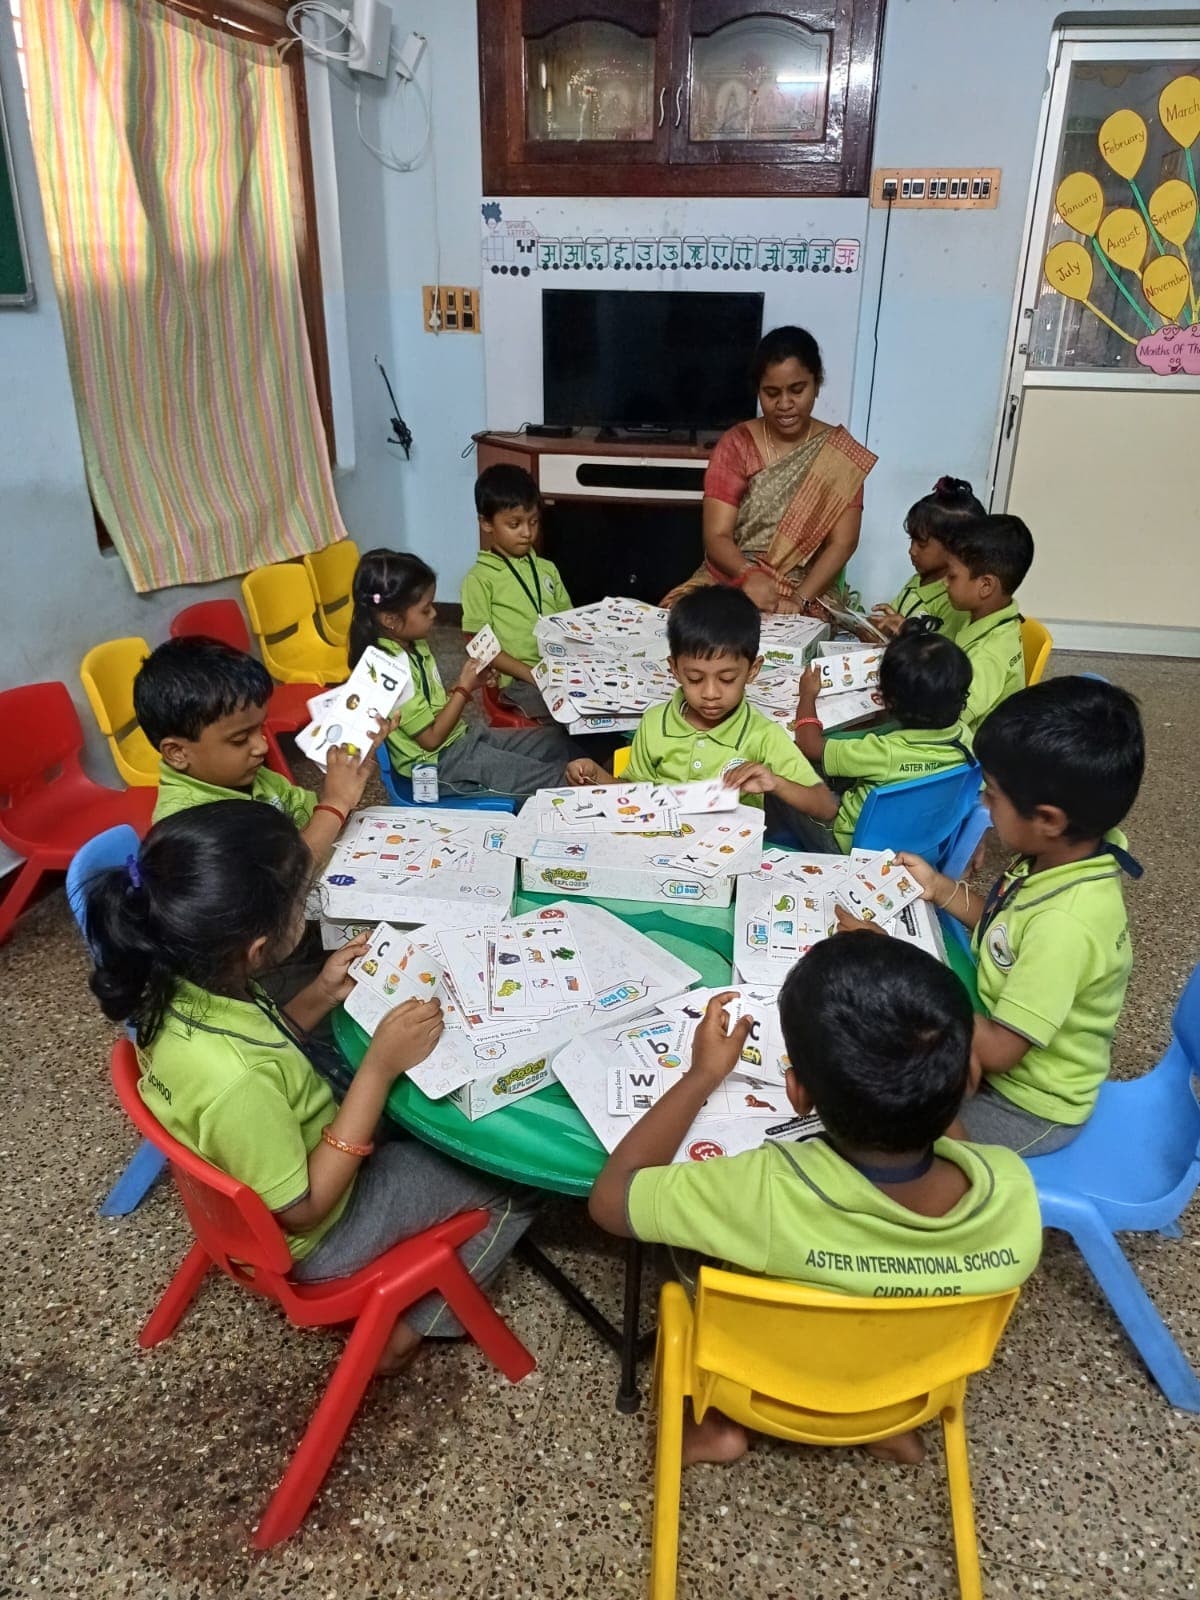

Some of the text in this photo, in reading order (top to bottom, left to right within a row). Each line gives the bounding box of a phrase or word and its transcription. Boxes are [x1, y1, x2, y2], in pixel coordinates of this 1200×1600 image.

[1166, 97, 1200, 122] March
[1102, 130, 1145, 156] February
[1060, 191, 1098, 217] January
[1151, 199, 1194, 226] September
[1106, 225, 1141, 252] August
[540, 245, 557, 263] अ
[564, 245, 584, 263] आ
[1056, 260, 1081, 282] July
[1145, 273, 1187, 298] November
[1140, 344, 1170, 356] Months
[1173, 344, 1184, 354] Of
[899, 763, 923, 772] ASTER
[646, 1038, 669, 1055] b
[805, 1247, 1020, 1275] ASTER INTERNATIONAL SCHOOL
